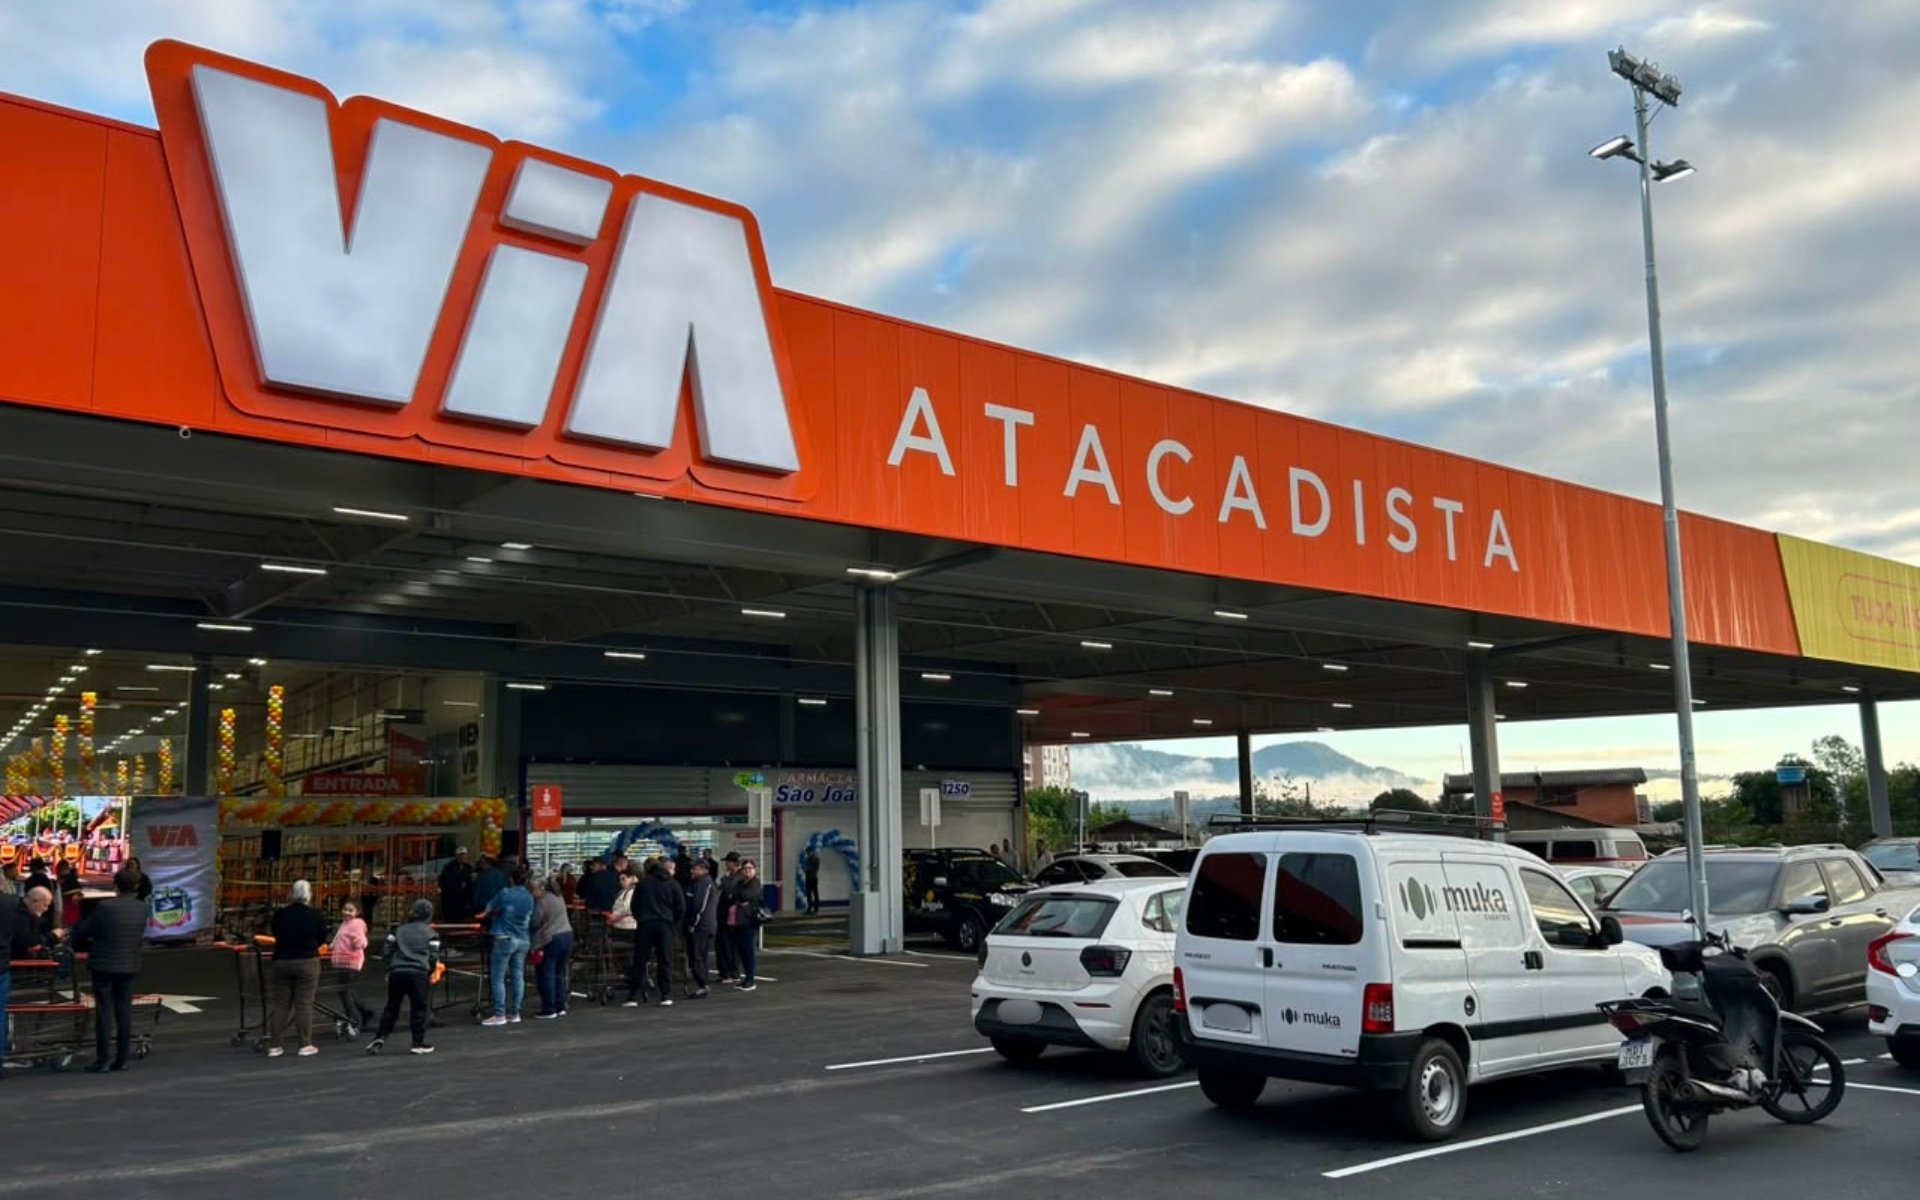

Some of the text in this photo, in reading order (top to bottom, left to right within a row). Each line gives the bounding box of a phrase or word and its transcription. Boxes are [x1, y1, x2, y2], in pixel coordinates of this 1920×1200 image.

[887, 385, 1520, 574] ATACADISTA
[313, 777, 400, 792] ENTRADA
[943, 783, 970, 794] 1250
[1442, 881, 1508, 913] muka
[1303, 1011, 1341, 1027] muka
